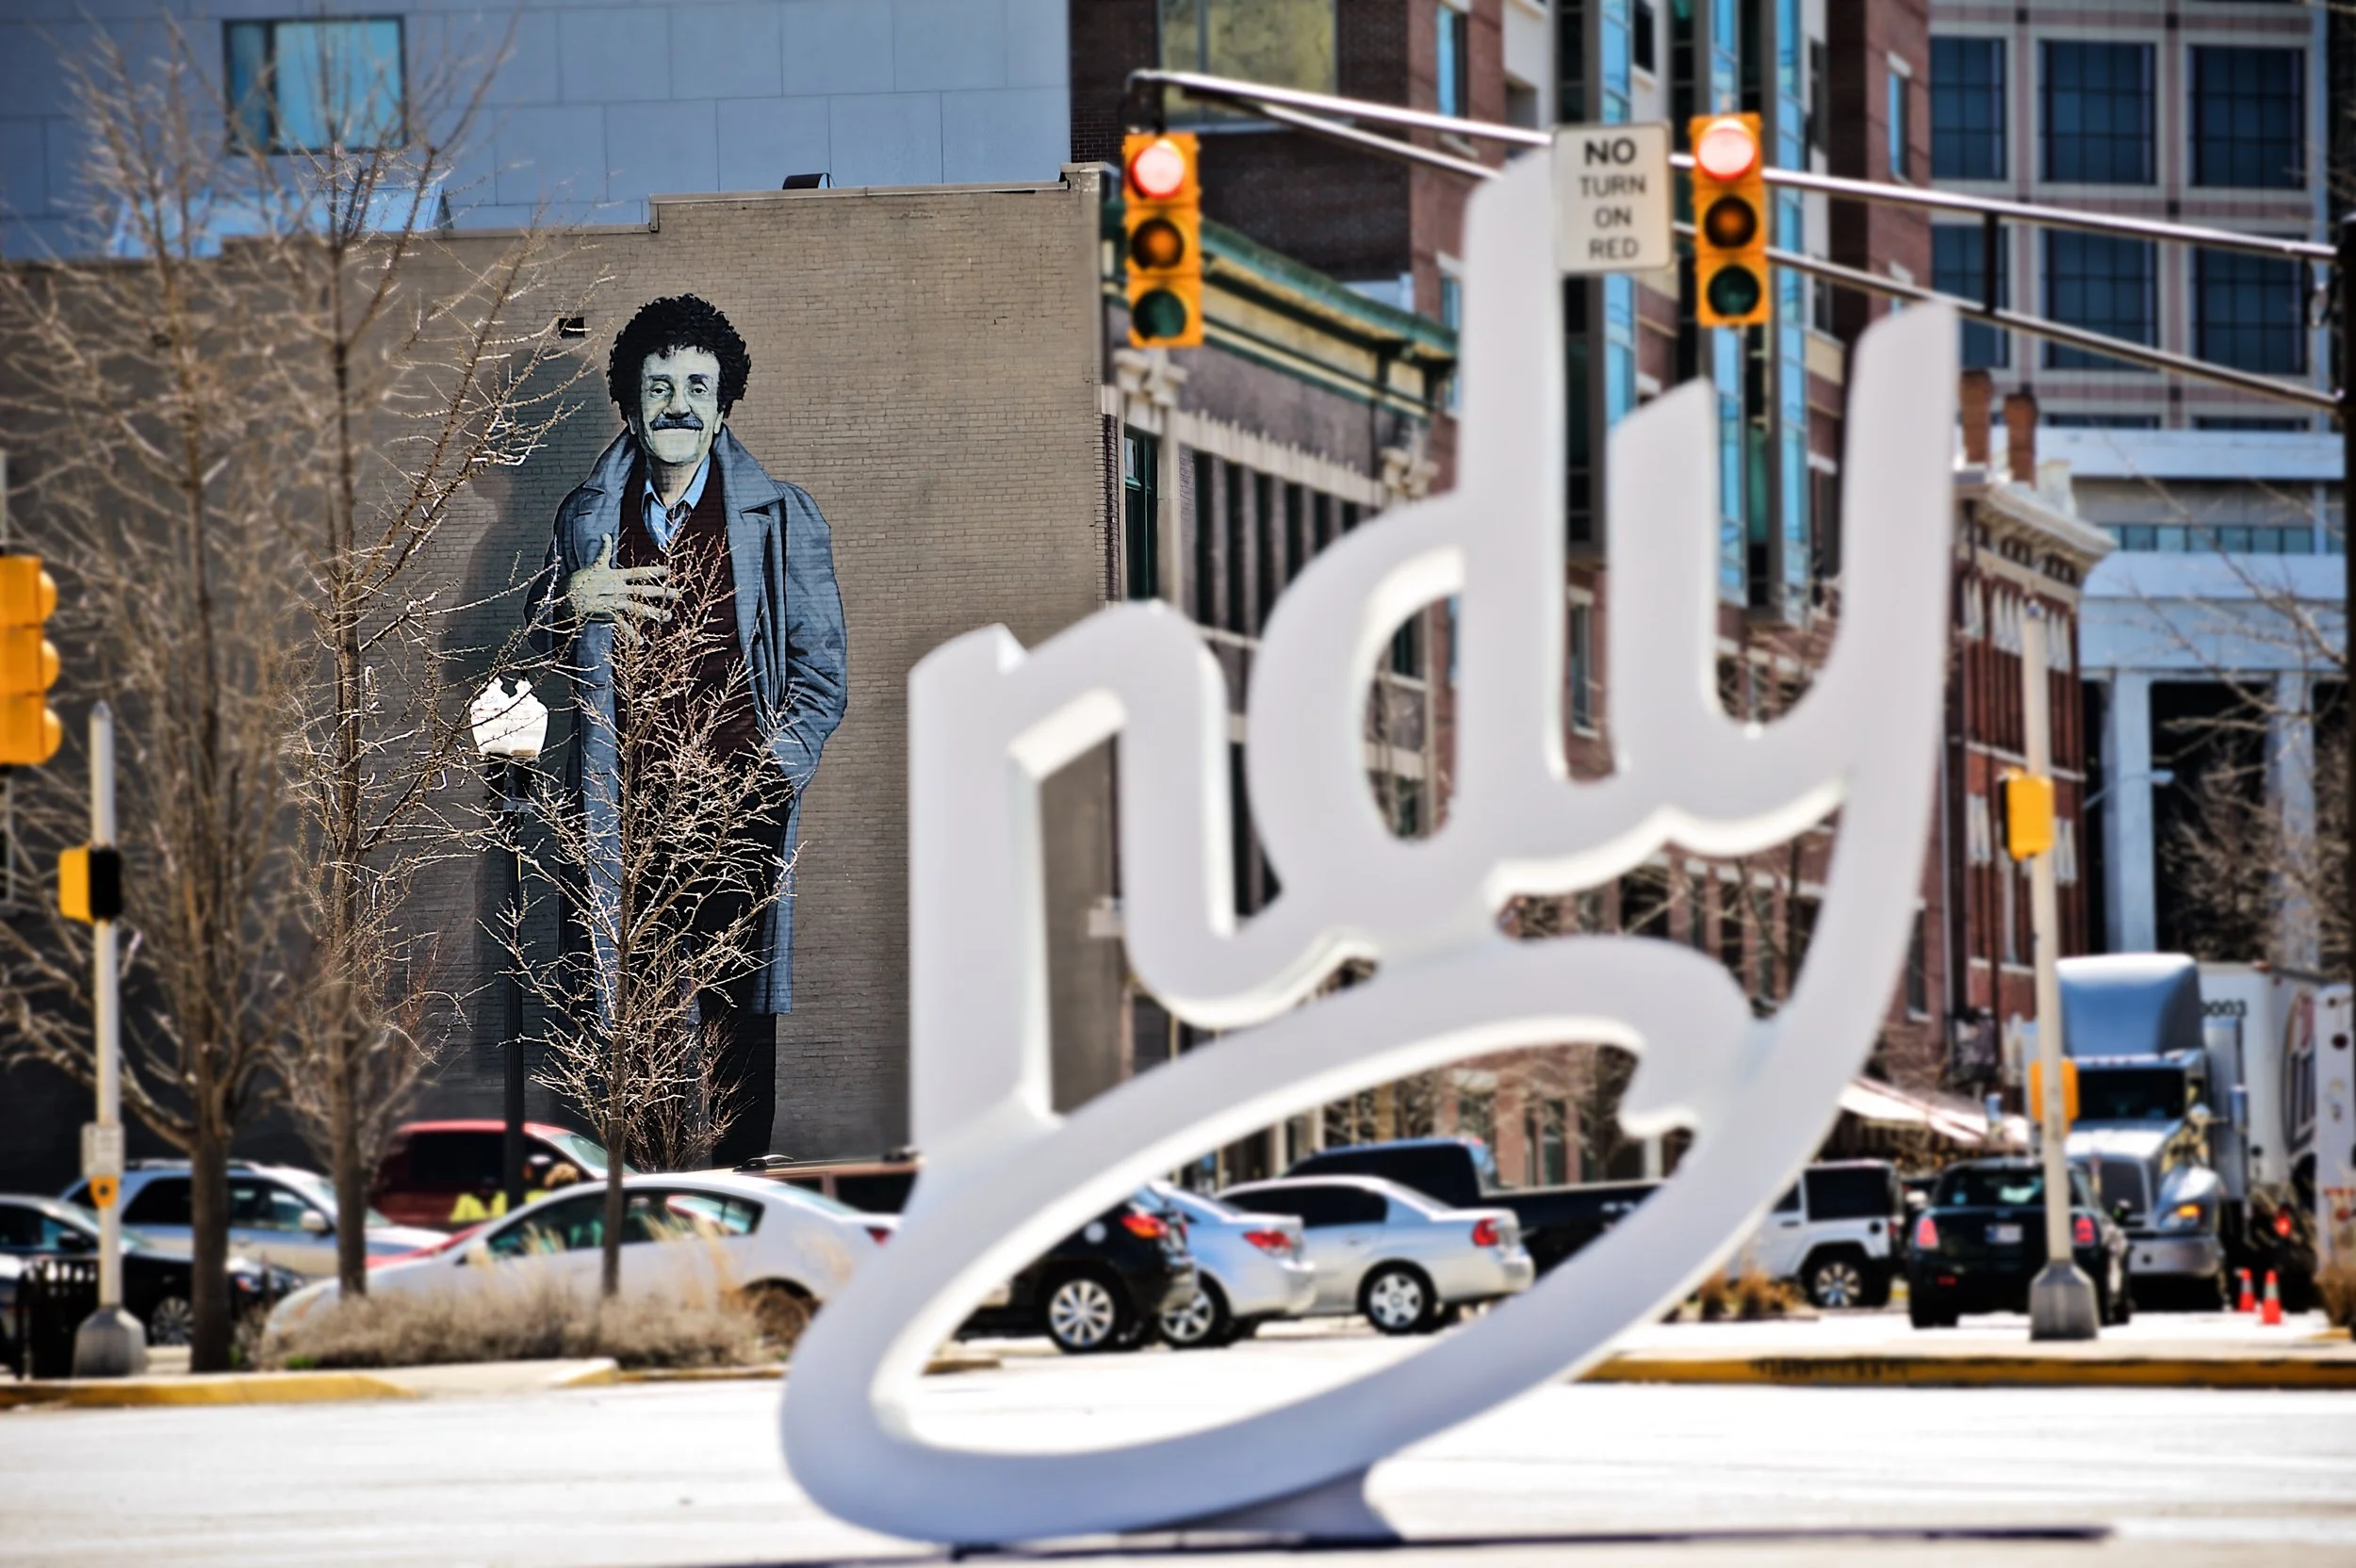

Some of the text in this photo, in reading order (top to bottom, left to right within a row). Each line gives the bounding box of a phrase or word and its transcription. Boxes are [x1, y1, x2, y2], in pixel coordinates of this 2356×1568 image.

[1584, 139, 1637, 166] NO
[1579, 174, 1647, 198] TURN
[1594, 206, 1632, 229] ON
[1588, 237, 1639, 260] RED
